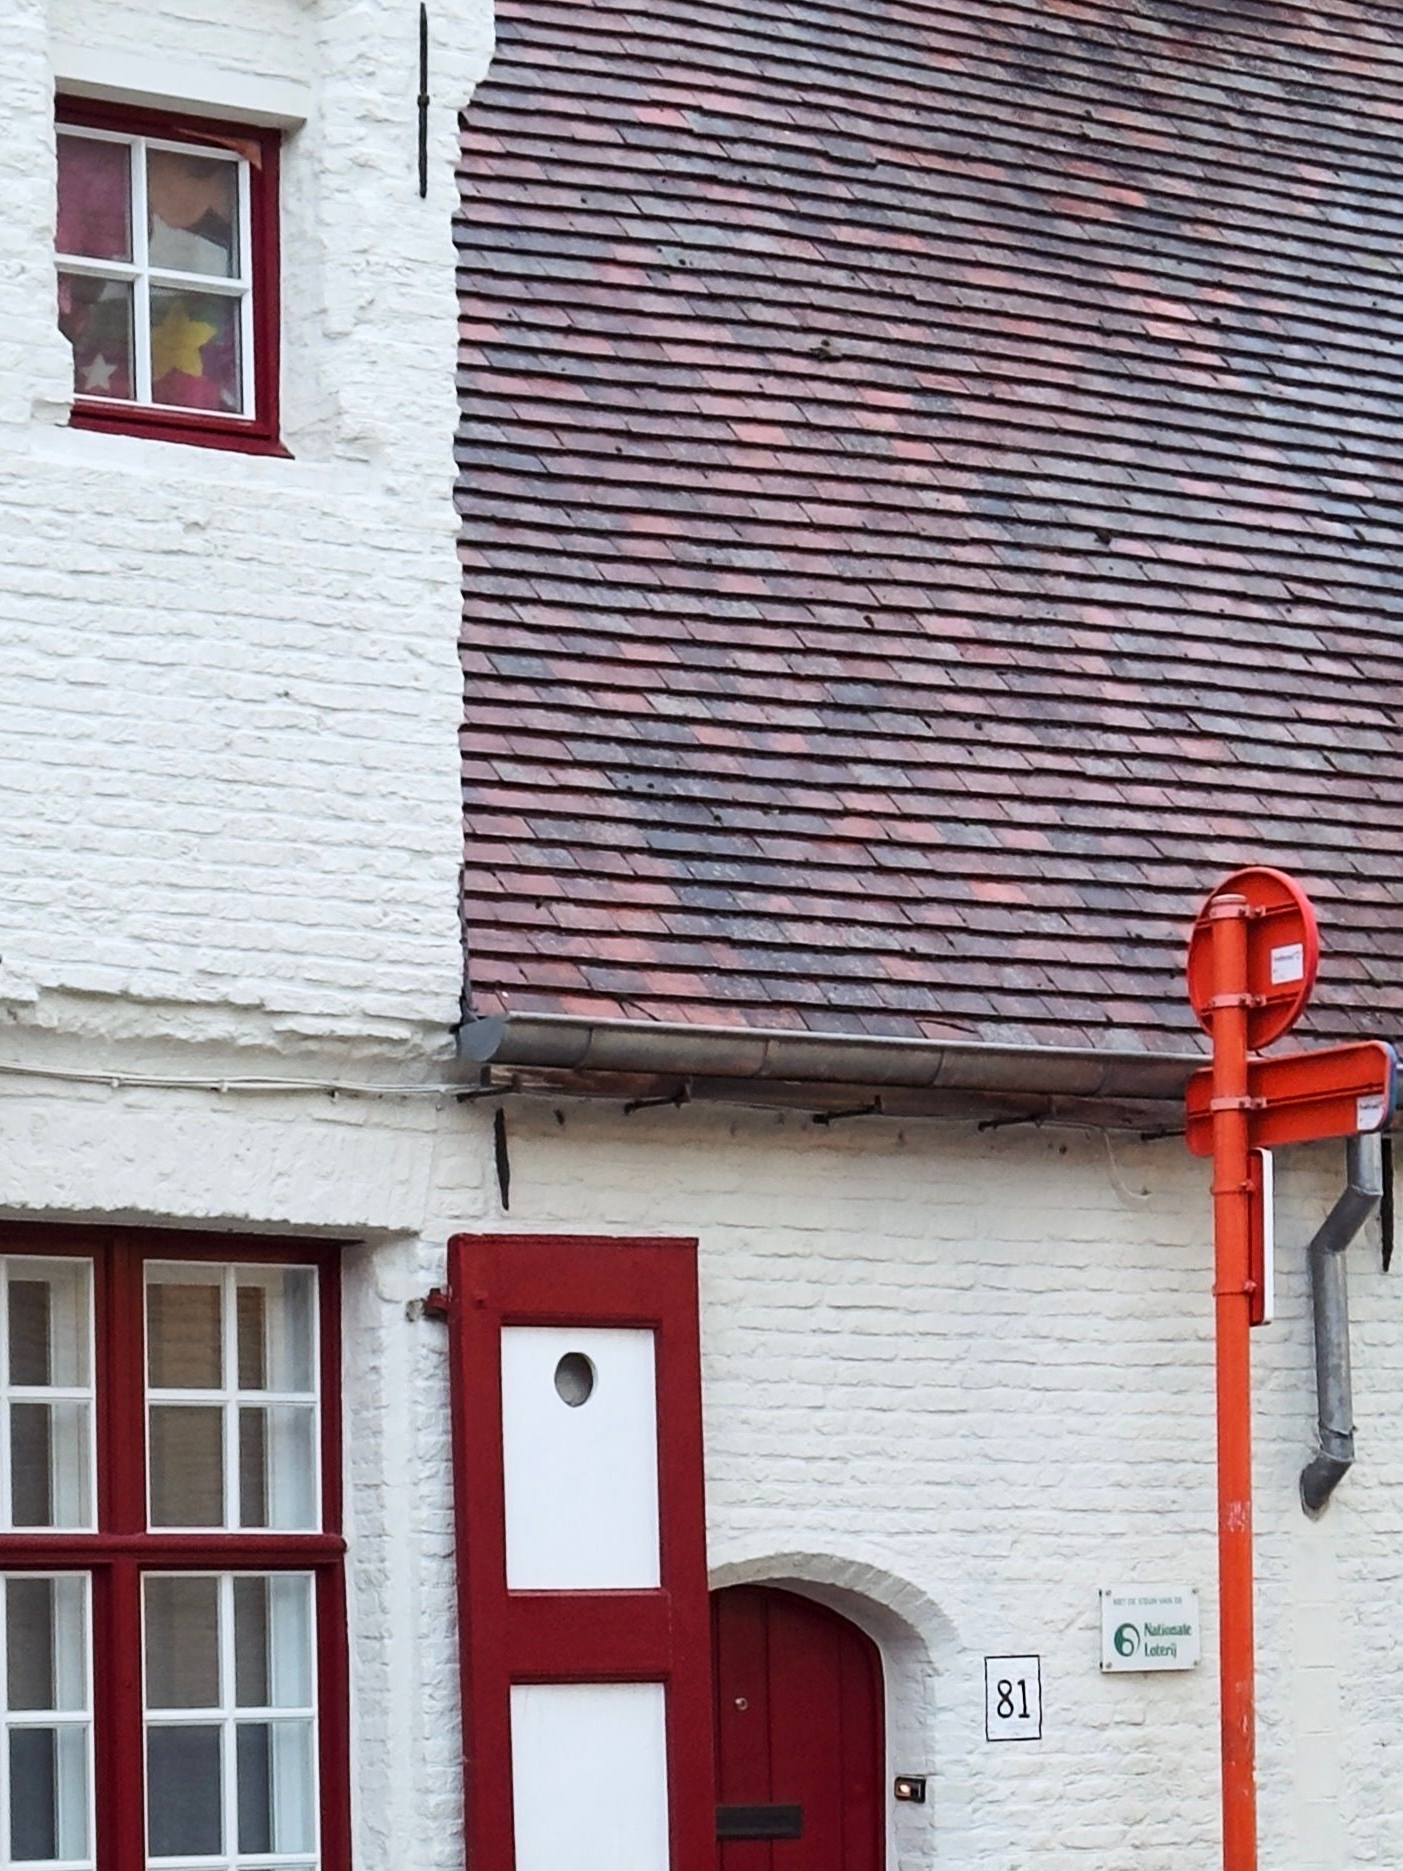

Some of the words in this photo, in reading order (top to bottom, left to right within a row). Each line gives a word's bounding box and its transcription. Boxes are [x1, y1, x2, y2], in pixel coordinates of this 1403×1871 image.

[1144, 1622, 1192, 1636] Nationale
[1145, 1643, 1177, 1659] Loterij
[997, 1679, 1030, 1719] 81
